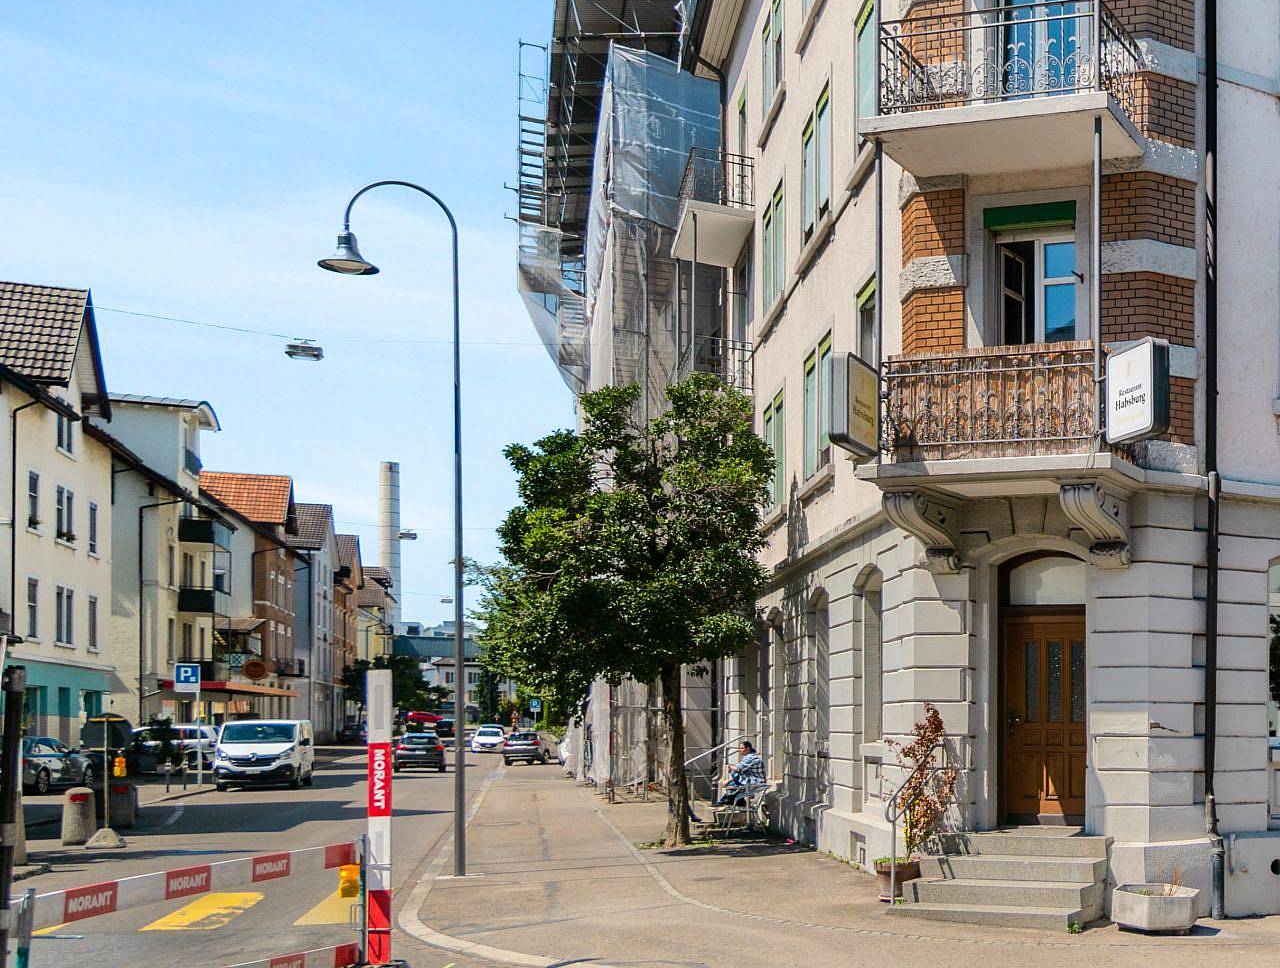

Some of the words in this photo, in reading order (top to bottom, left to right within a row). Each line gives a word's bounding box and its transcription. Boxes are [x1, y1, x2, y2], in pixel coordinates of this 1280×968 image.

[1115, 392, 1146, 411] Habsburg
[180, 667, 192, 681] P
[373, 748, 386, 810] MORANT
[68, 890, 113, 914] MORANT
[169, 871, 208, 893] MORANT
[256, 859, 288, 877] MORANT
